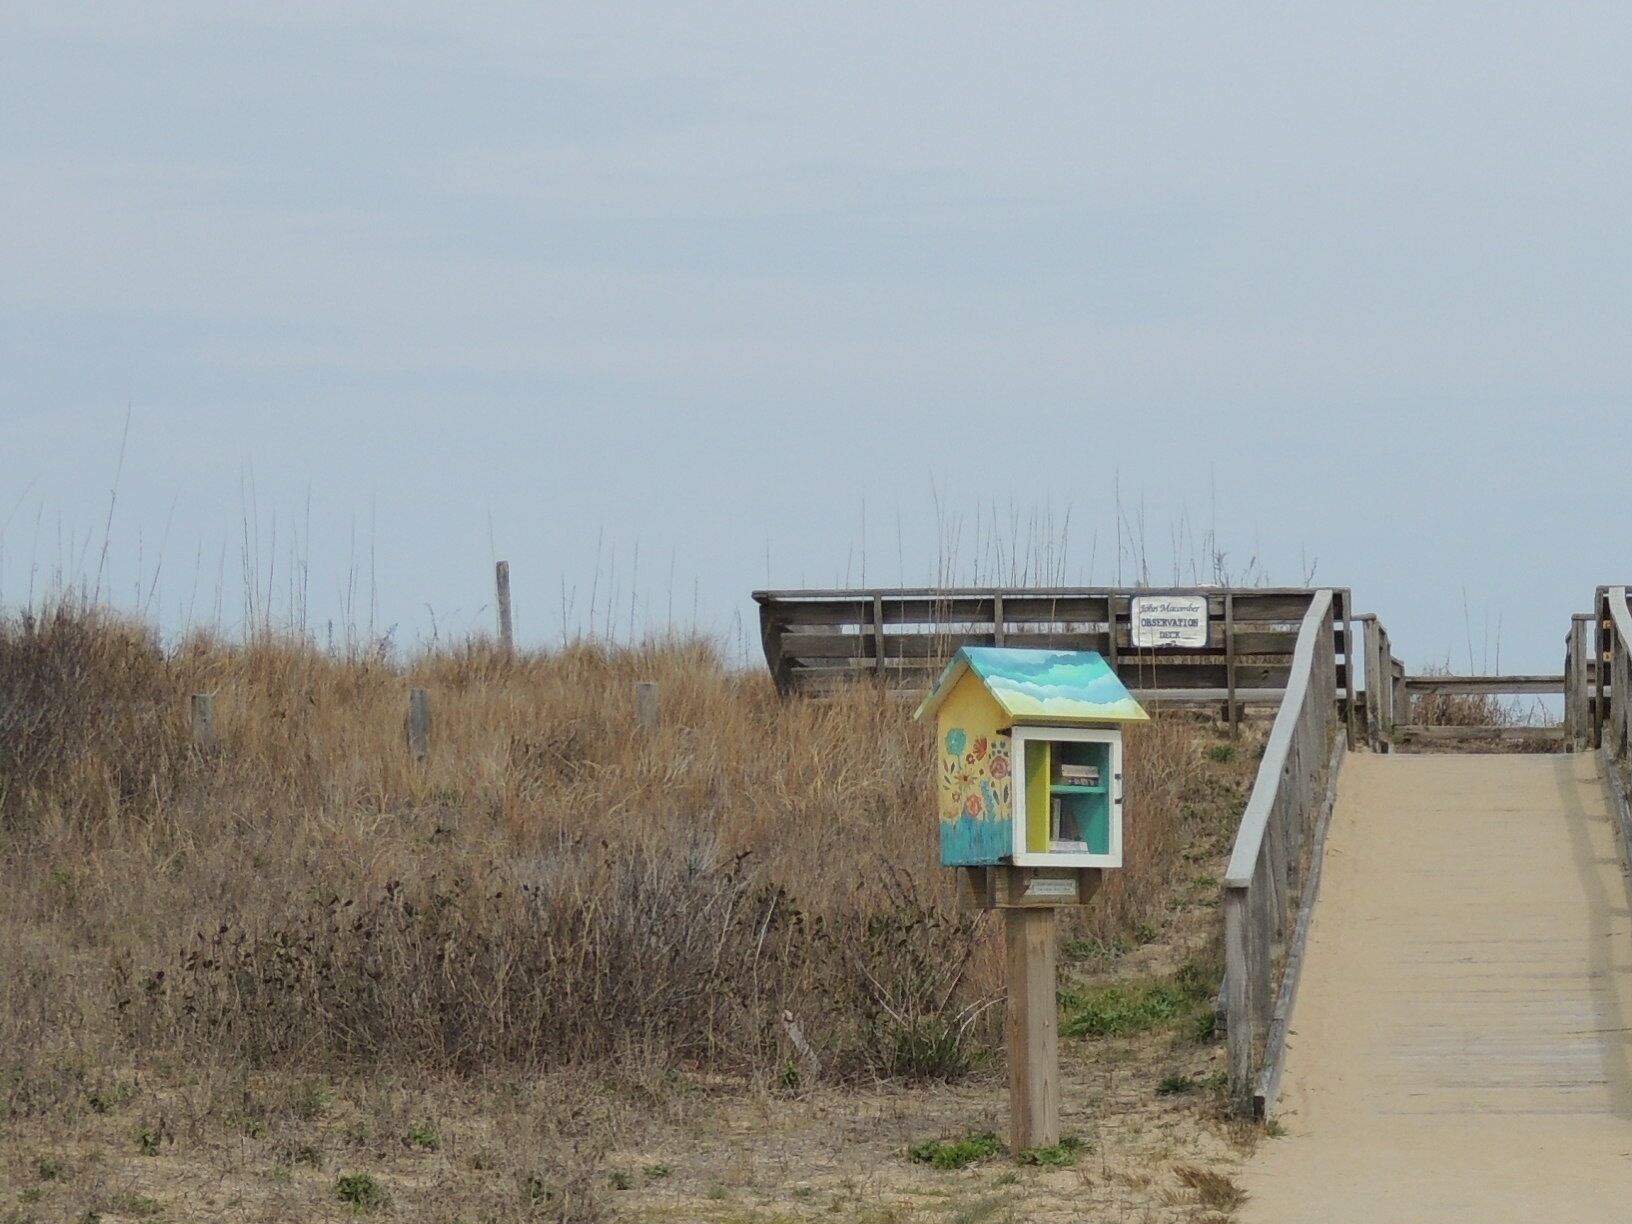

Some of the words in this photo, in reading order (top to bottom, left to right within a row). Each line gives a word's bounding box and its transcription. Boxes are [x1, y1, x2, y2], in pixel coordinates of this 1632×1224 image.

[1140, 604, 1158, 613] John
[1141, 618, 1199, 628] OBSERVATION
[1159, 630, 1181, 639] DECK
